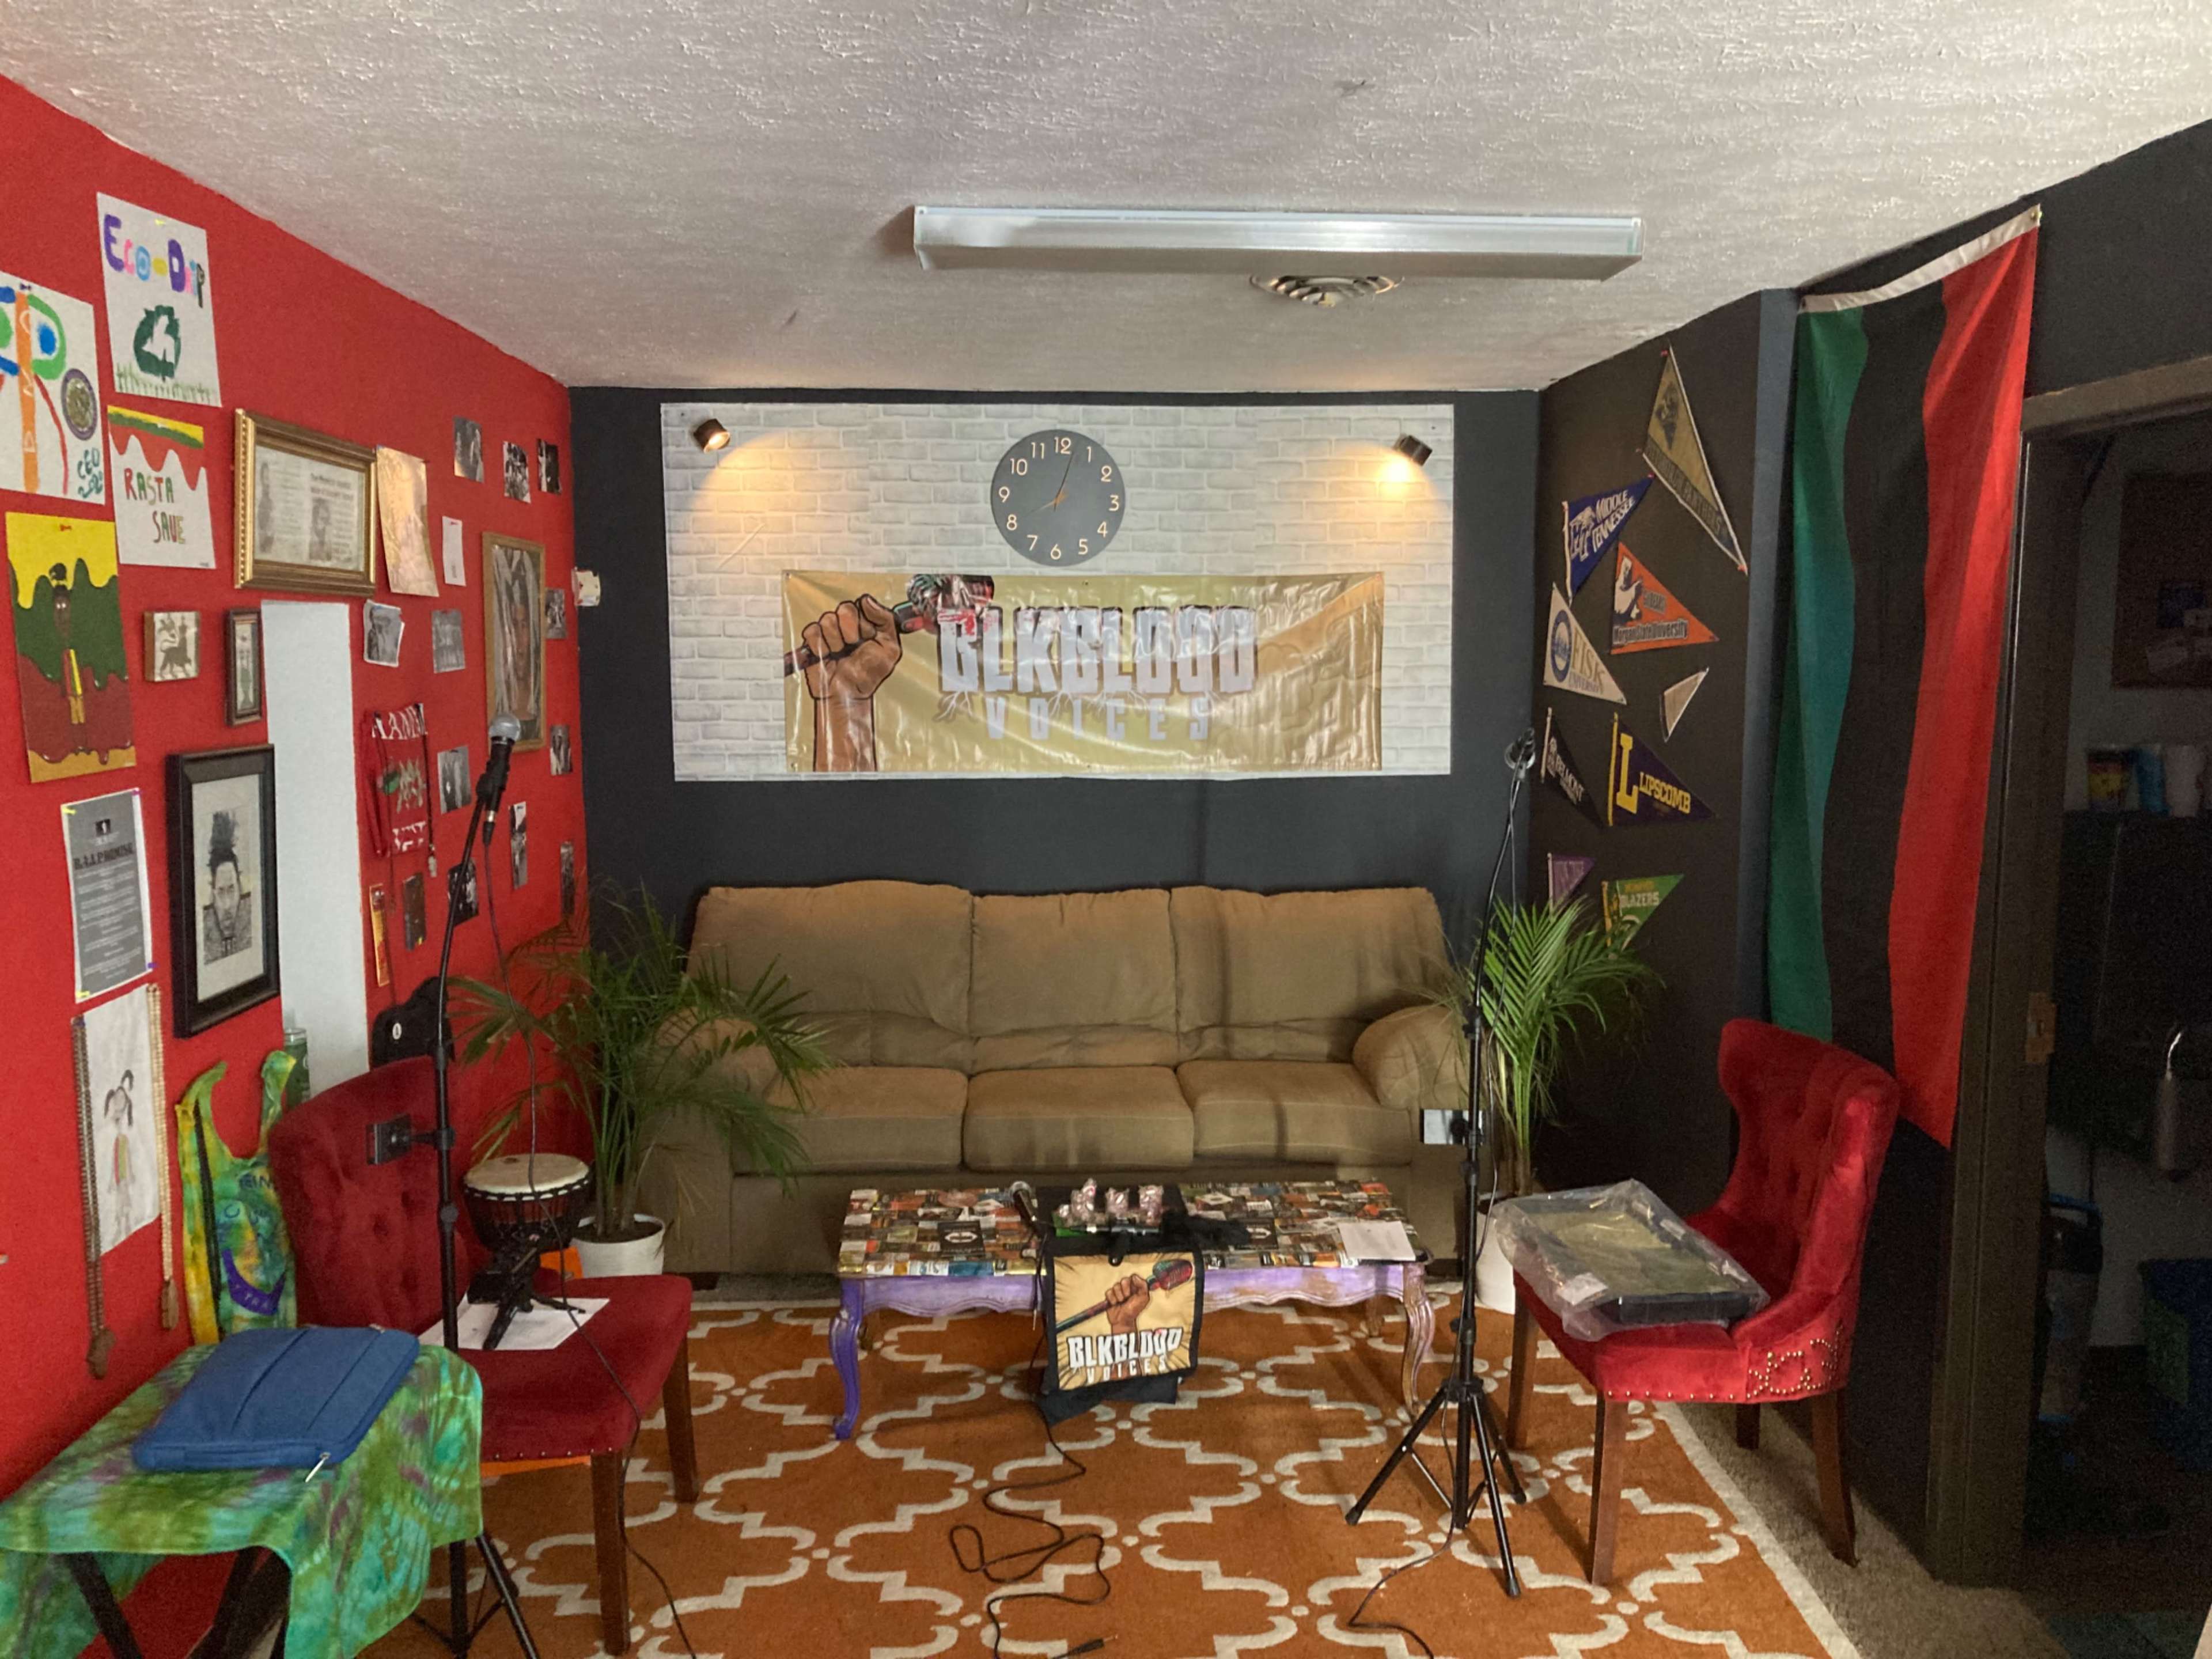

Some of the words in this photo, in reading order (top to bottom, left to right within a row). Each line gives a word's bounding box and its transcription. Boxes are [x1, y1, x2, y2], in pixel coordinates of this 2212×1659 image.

[1031, 442, 1046, 460] 11
[1054, 437, 1071, 454] 12
[1086, 446, 1092, 463] 1
[1010, 458, 1028, 476] 10
[1101, 465, 1112, 482] 2
[124, 467, 175, 505] RASTA
[998, 486, 1010, 503] 9
[1109, 494, 1120, 512] 3
[1596, 489, 1629, 524] MIDDLE
[1006, 514, 1018, 531] 8
[1097, 521, 1108, 538] 4
[1592, 495, 1635, 553] TENNESSEE
[1027, 535, 1039, 551] 7
[1050, 544, 1062, 560] 6
[1078, 538, 1089, 555] 5
[937, 606, 1258, 694] BLKBLOOD
[1573, 626, 1605, 695] FISK
[984, 695, 1211, 741] VOICES
[1616, 733, 1639, 815] L
[1639, 771, 1691, 814] LIPSCOMB
[1067, 1327, 1183, 1369] BLKBLOOD
[1086, 1354, 1168, 1385] VOICES
